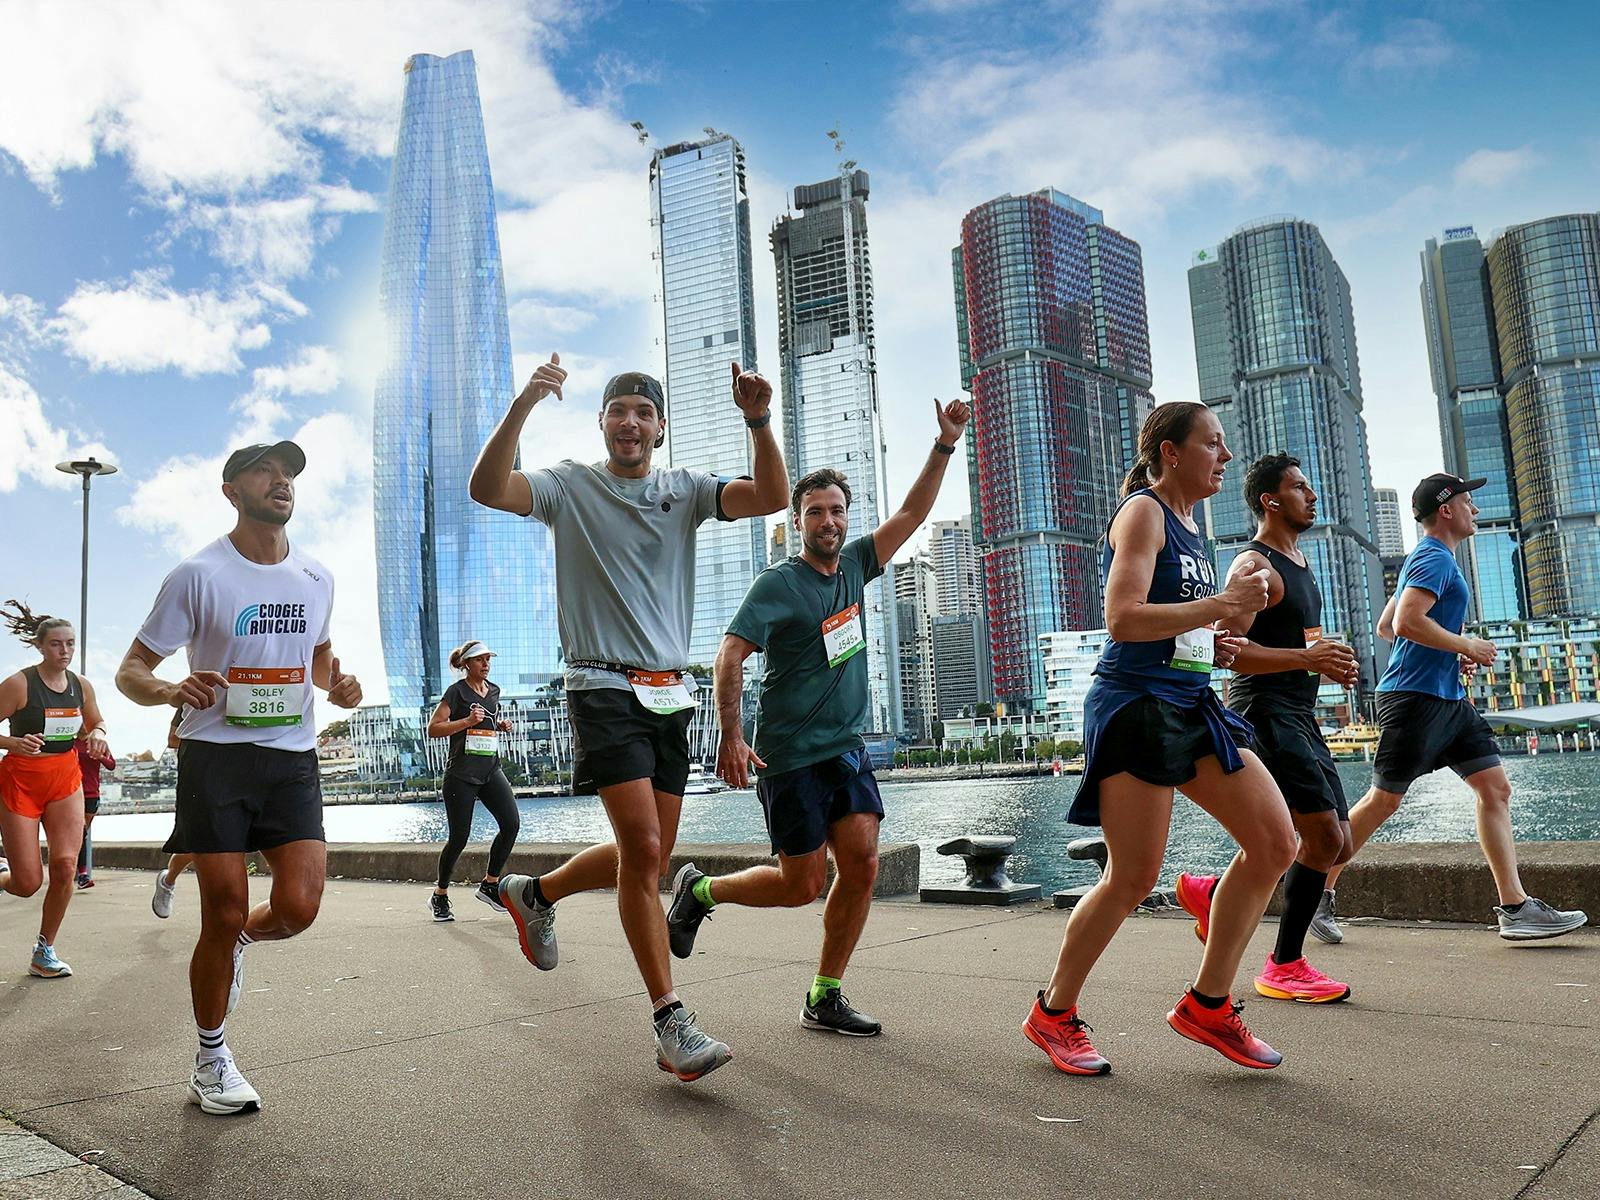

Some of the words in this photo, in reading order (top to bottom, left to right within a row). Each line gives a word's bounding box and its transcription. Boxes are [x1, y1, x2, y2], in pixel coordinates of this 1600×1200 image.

[1446, 229, 1472, 240] KPMG
[1180, 582, 1216, 599] SQUA
[259, 603, 306, 618] COOGEE
[590, 661, 608, 669] CLUB
[237, 672, 262, 680] 21.1KM
[251, 688, 285, 697] SOLEY
[653, 698, 680, 706] 4575
[249, 701, 285, 714] 3816
